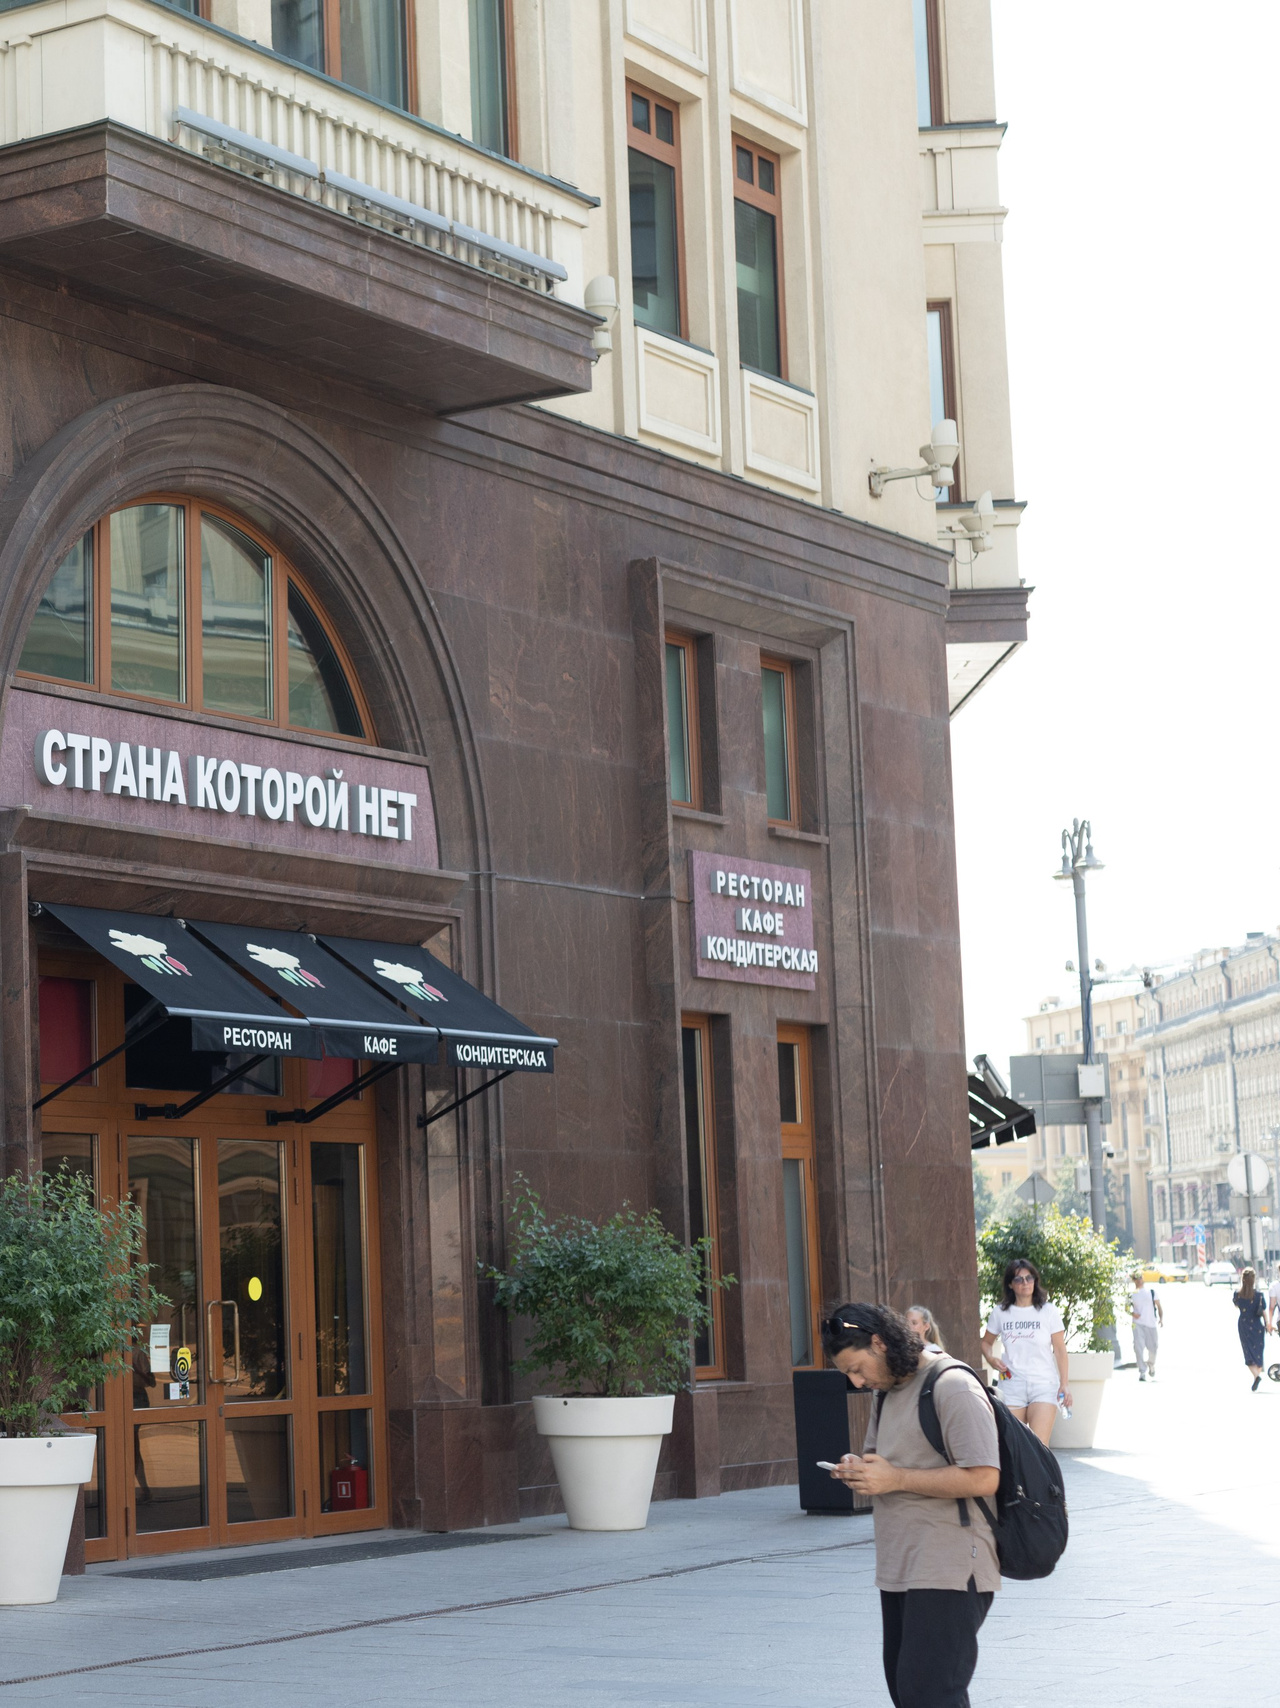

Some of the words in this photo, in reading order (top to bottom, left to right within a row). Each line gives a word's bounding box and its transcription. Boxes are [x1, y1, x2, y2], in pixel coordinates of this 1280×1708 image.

[42, 728, 187, 806] СТРАНА
[196, 755, 349, 832] КОТОРОЙ
[358, 785, 418, 842] НЕТ
[716, 870, 806, 908] РЕСТОРАН
[741, 907, 785, 937] КАФЕ
[706, 935, 819, 973] КОНДИТЕРСКАЯ
[223, 1026, 292, 1051] РЕСТОРАН
[363, 1035, 398, 1056] КАФЕ
[456, 1043, 547, 1068] КОНДИТЕРСКАЯ
[1003, 1322, 1014, 1331] LEE
[1014, 1321, 1041, 1330] COOPER
